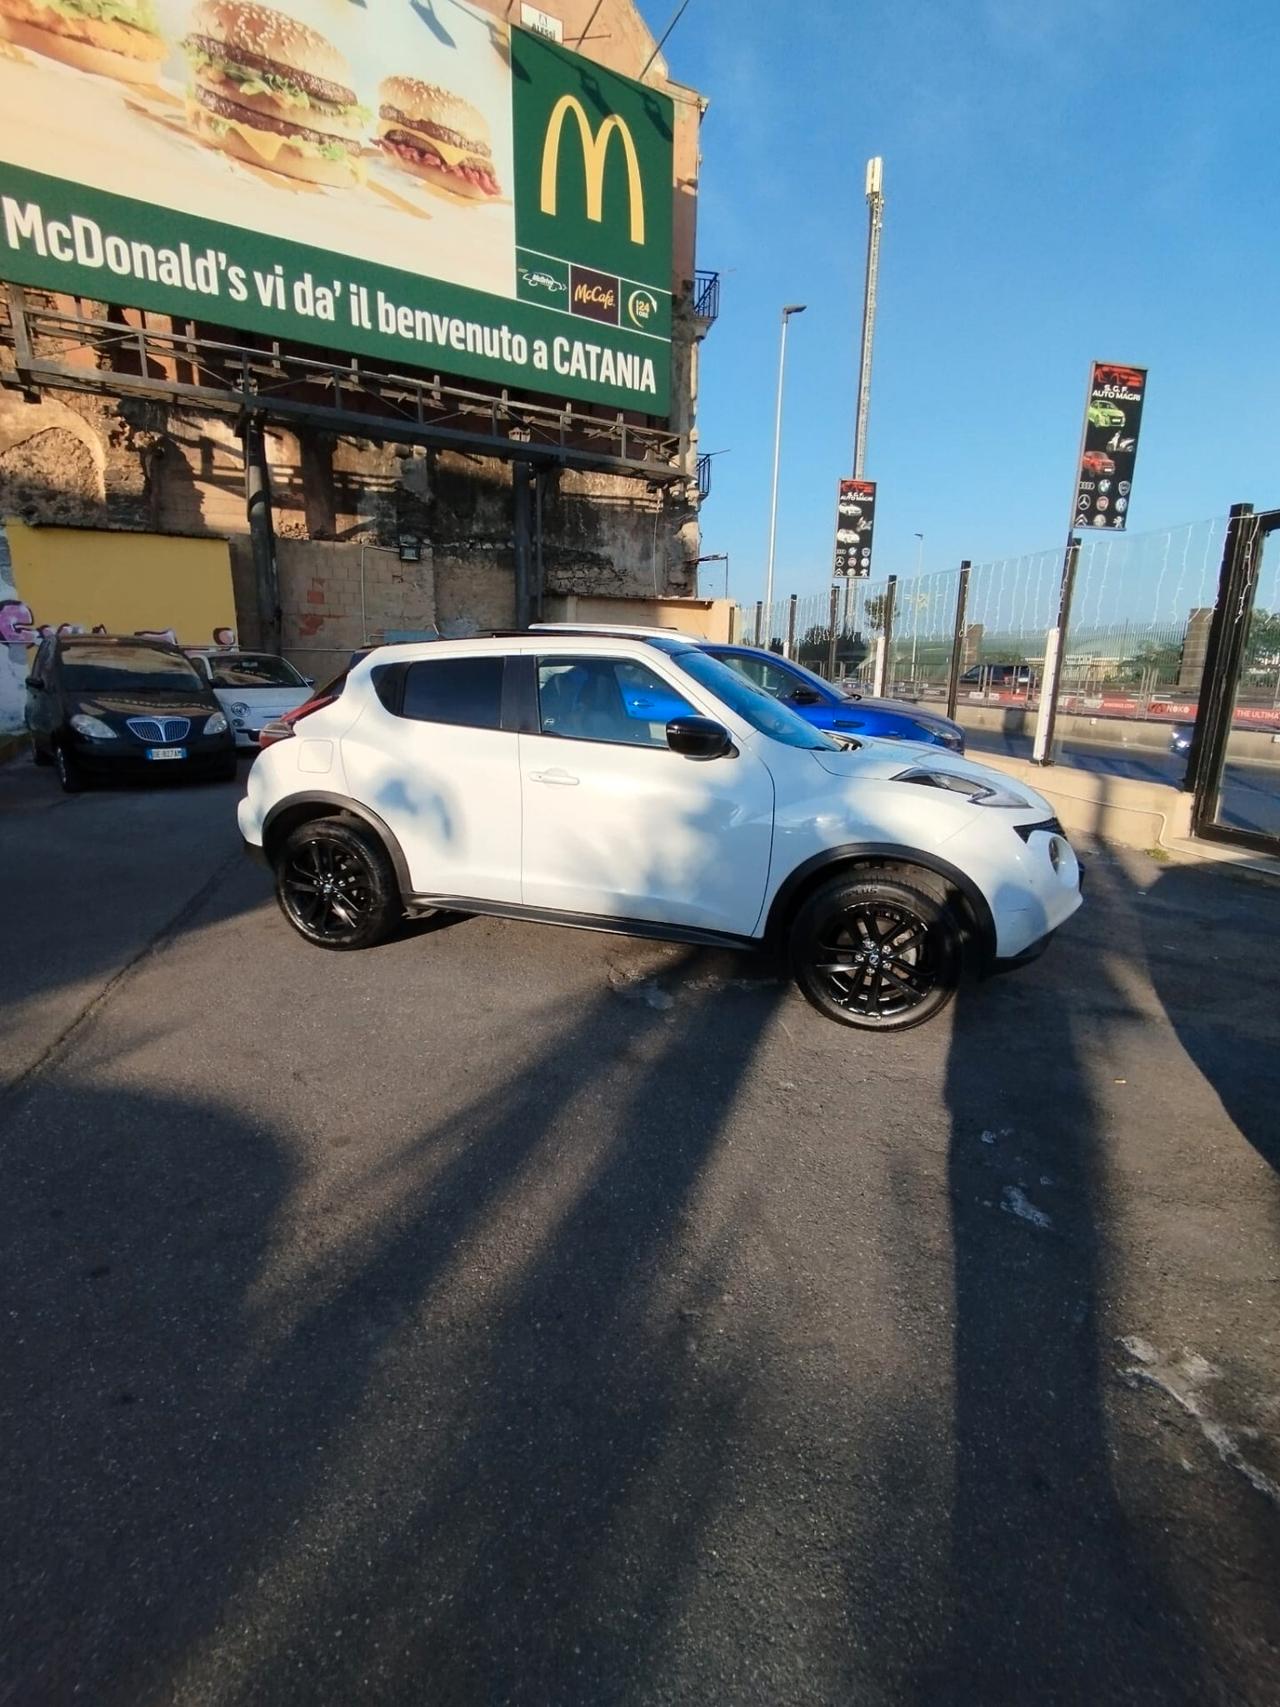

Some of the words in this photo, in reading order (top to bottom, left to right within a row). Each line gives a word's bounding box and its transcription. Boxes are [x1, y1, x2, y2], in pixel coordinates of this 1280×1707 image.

[2, 196, 248, 302] McDonald's
[253, 264, 286, 310] vi
[293, 272, 341, 321] da'
[349, 282, 372, 330] il
[377, 290, 528, 366] benvenuto
[532, 339, 548, 371] a
[552, 336, 657, 395] CATANIA
[1092, 389, 1115, 399] AUTO
